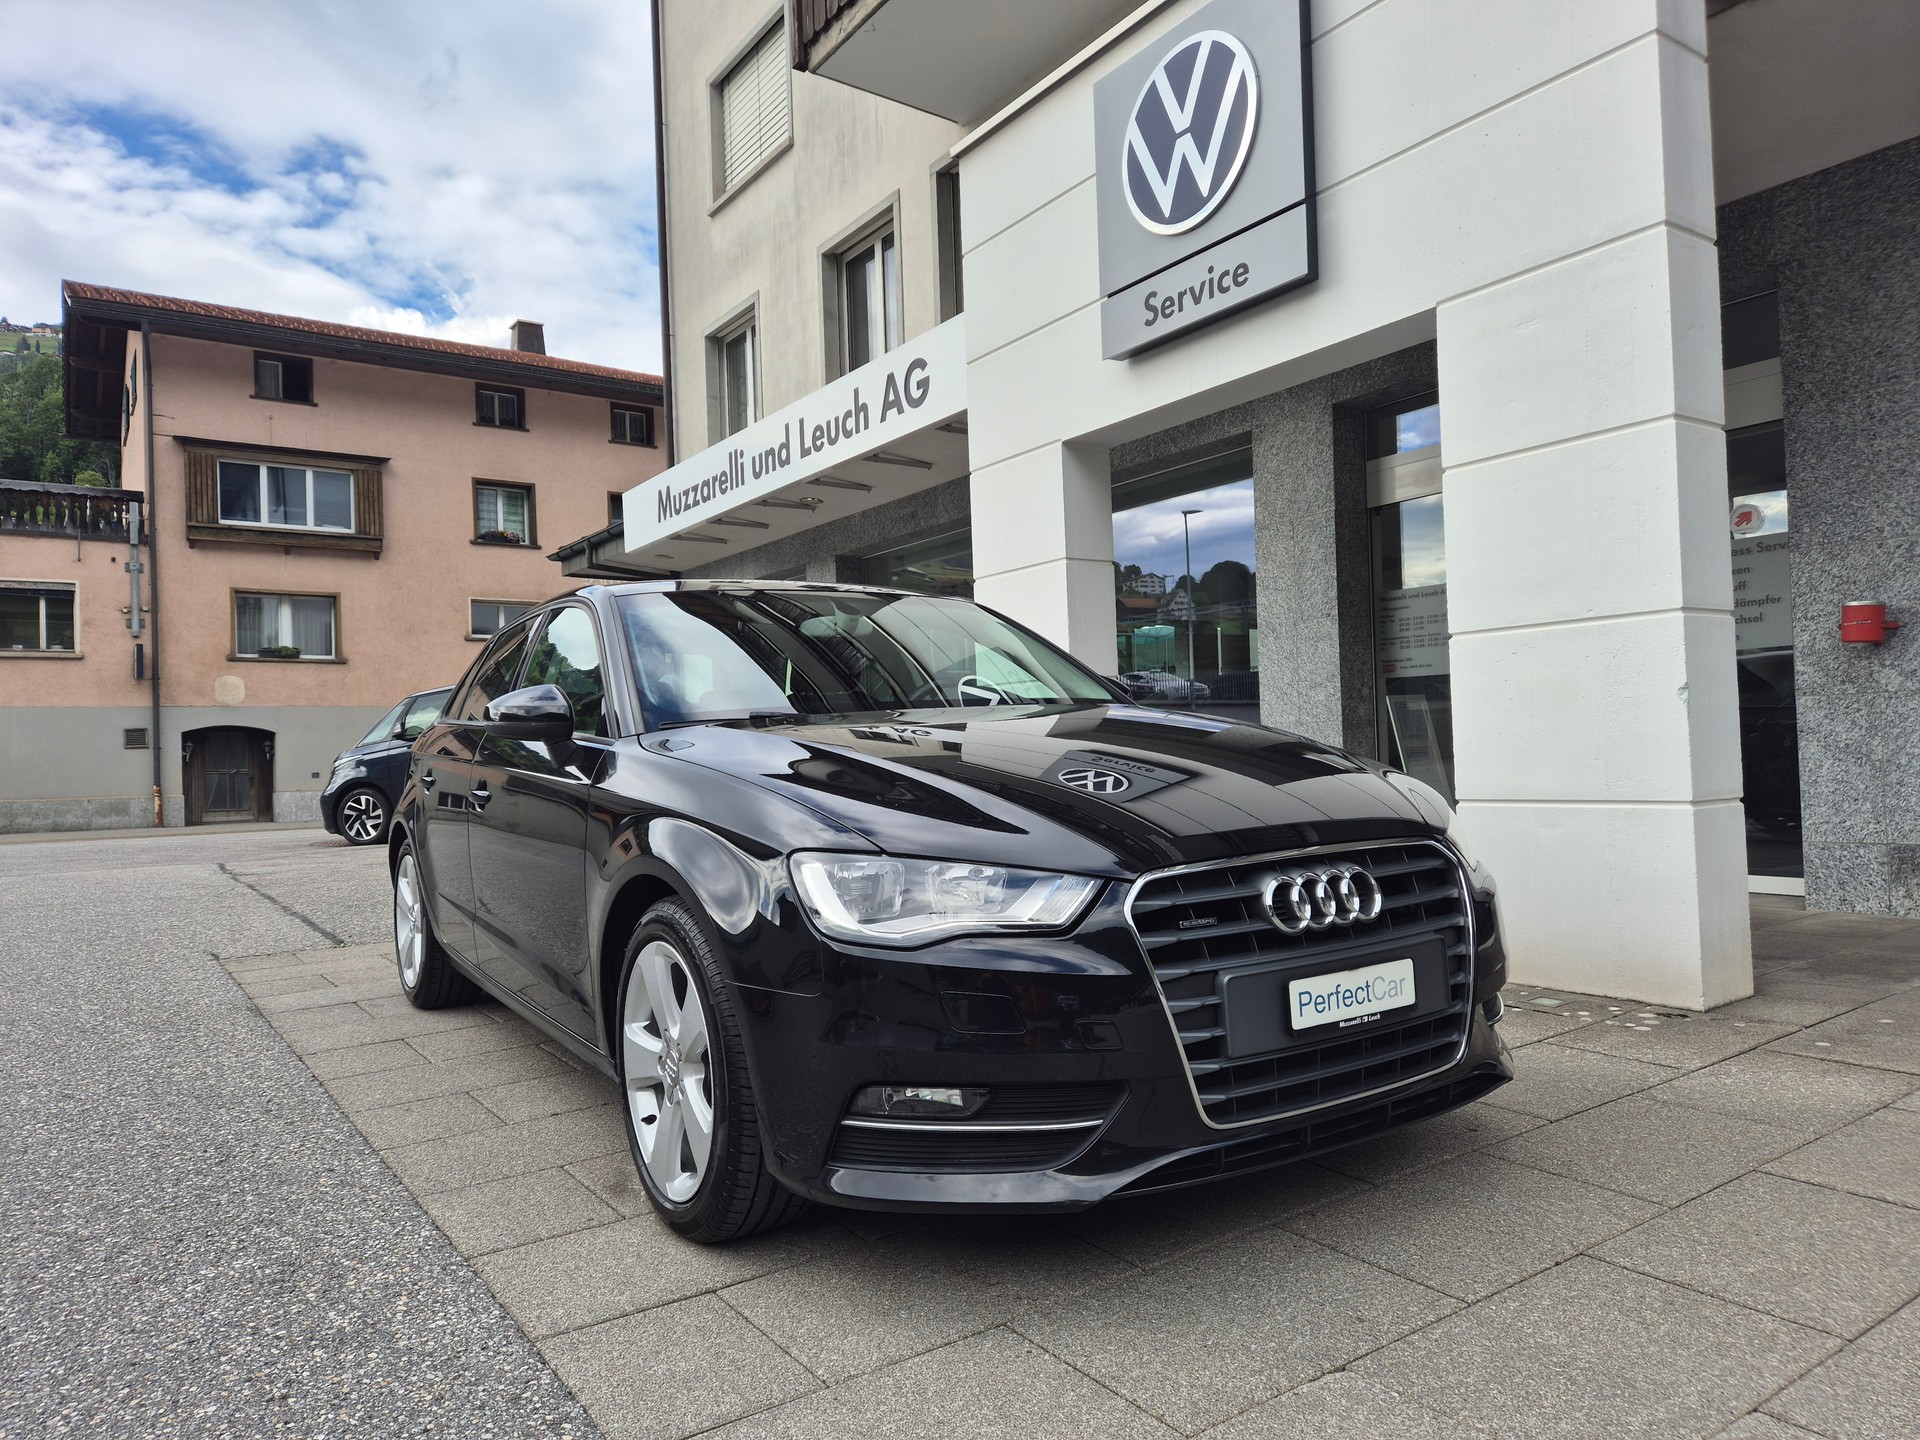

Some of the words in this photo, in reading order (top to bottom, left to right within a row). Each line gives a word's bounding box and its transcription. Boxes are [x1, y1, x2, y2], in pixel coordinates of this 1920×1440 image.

[1124, 33, 1256, 228] VW
[1144, 262, 1250, 327] Service
[657, 448, 746, 524] Muzzarelli
[751, 423, 791, 480] und
[799, 387, 870, 460] Leuch
[880, 357, 931, 424] AG
[1298, 975, 1406, 1018] PerfectCar
